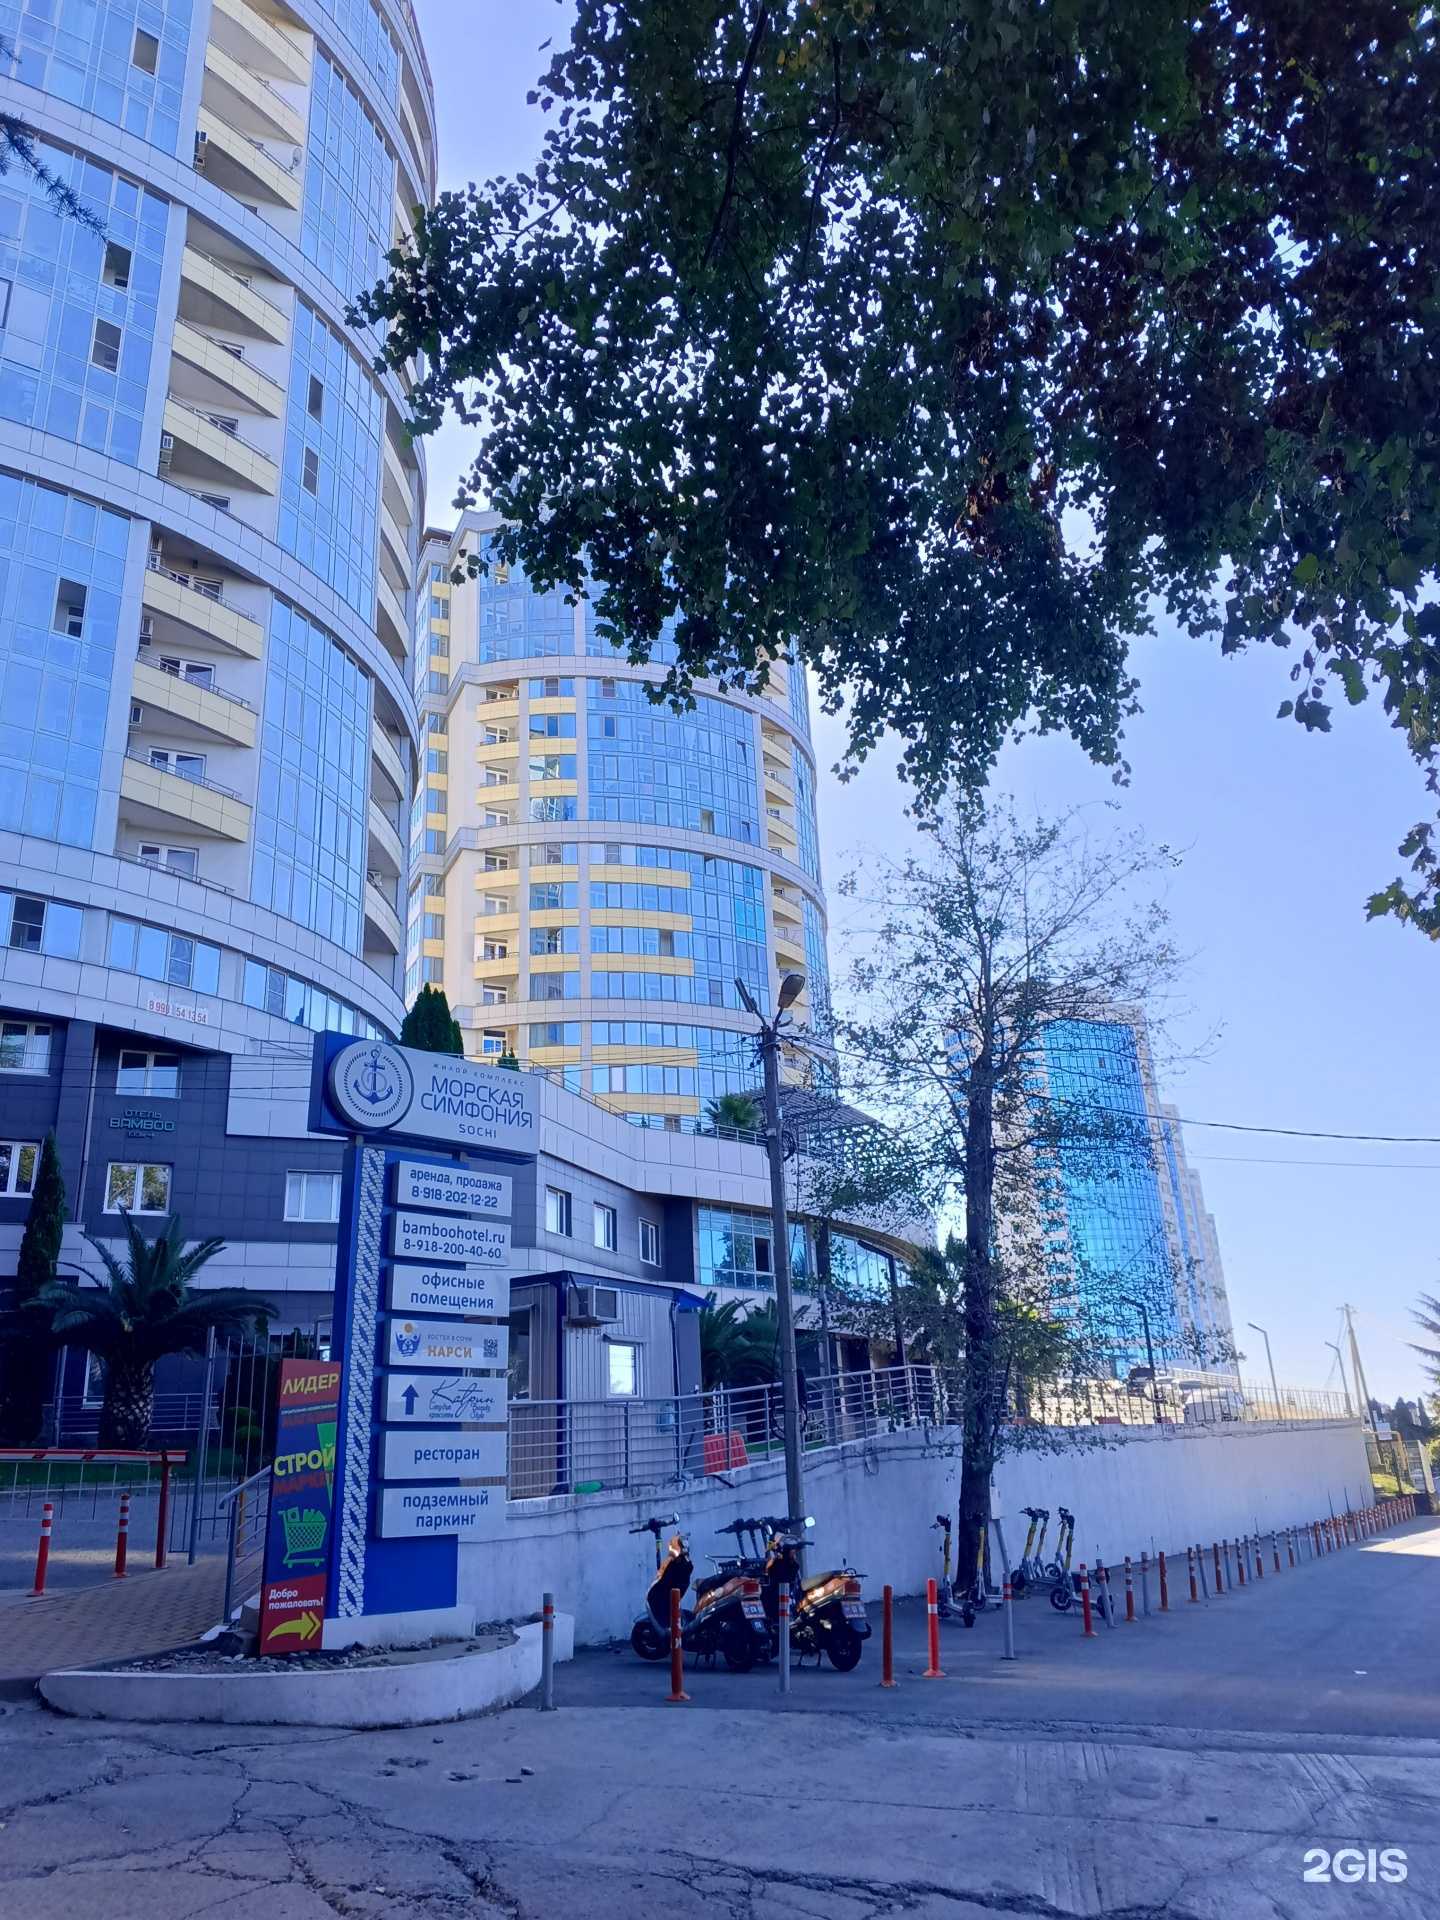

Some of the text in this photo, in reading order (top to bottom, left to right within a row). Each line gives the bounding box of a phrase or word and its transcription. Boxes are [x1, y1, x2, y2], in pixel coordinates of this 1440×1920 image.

[431, 1075, 524, 1109] МОРСКАЯ
[421, 1092, 533, 1128] СИМФОНИЯ
[458, 1123, 497, 1139] SOCHI
[410, 1169, 503, 1191] аренда, продажа
[402, 1219, 505, 1244] bamboohotel.ru
[403, 1238, 502, 1258] 8-918-200-40-60
[422, 1272, 485, 1290] офисные
[410, 1292, 494, 1310] помещения
[427, 1345, 473, 1358] НАРСИ
[282, 1373, 339, 1395] ЛИДЕР
[273, 1442, 336, 1476] СТРОЙ
[414, 1448, 480, 1465] ресторан
[403, 1490, 489, 1510] подземный
[416, 1513, 476, 1530] паркинг
[268, 1588, 299, 1600] Добро
[268, 1596, 324, 1610] пожаловать!
